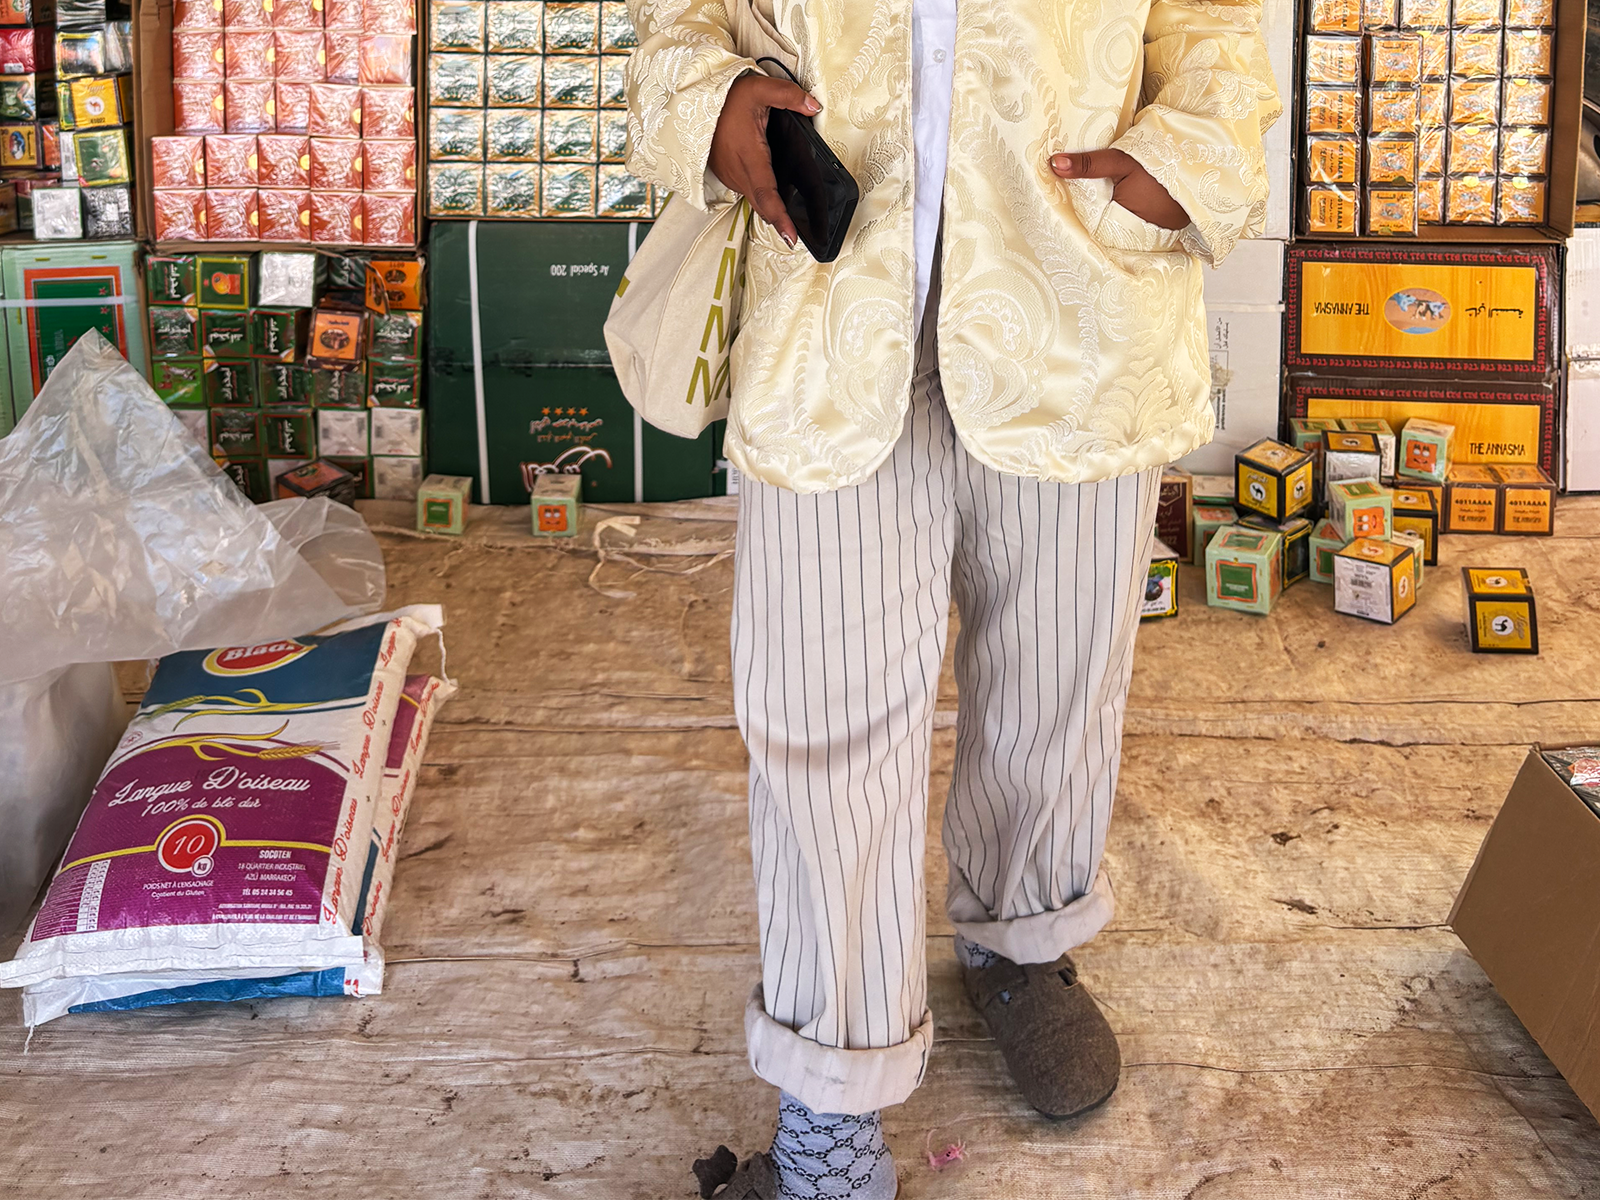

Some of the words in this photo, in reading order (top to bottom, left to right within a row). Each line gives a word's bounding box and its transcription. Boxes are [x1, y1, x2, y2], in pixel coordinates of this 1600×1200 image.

[550, 264, 568, 277] 200
[570, 262, 598, 277] Special
[600, 264, 610, 277] Ar
[1314, 302, 1354, 317] ANNASMA
[1355, 303, 1370, 316] THE
[1470, 442, 1485, 455] THE
[1485, 443, 1526, 456] ANNASMA
[108, 779, 194, 807] Langue
[202, 766, 311, 791] D'oiseau
[141, 798, 189, 817] 100%
[192, 797, 208, 809] de
[211, 797, 235, 809] blé
[238, 796, 262, 809] dur
[333, 797, 358, 863] D'oiseau
[173, 834, 206, 856] 10
[245, 862, 274, 871] QUARTIER
